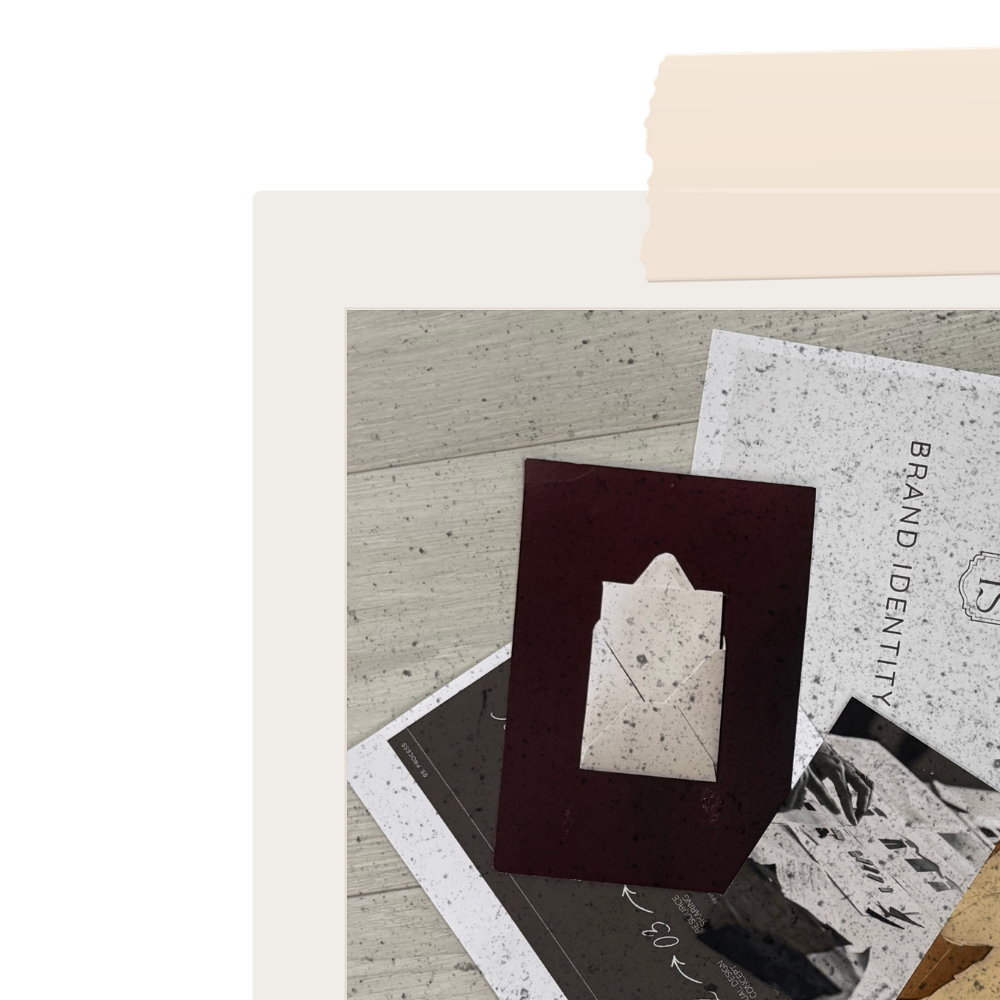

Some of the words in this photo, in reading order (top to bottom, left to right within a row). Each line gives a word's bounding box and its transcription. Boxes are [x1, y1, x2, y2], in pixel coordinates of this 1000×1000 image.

[896, 440, 932, 549] BRAND
[872, 563, 913, 707] IDENTITY
[401, 742, 421, 769] PROCESS
[671, 894, 703, 934] RESOURCE
[681, 893, 707, 927] SHARING
[641, 921, 680, 948] 03
[716, 959, 739, 988] DESIGN
[729, 965, 757, 999] CONCEPT
